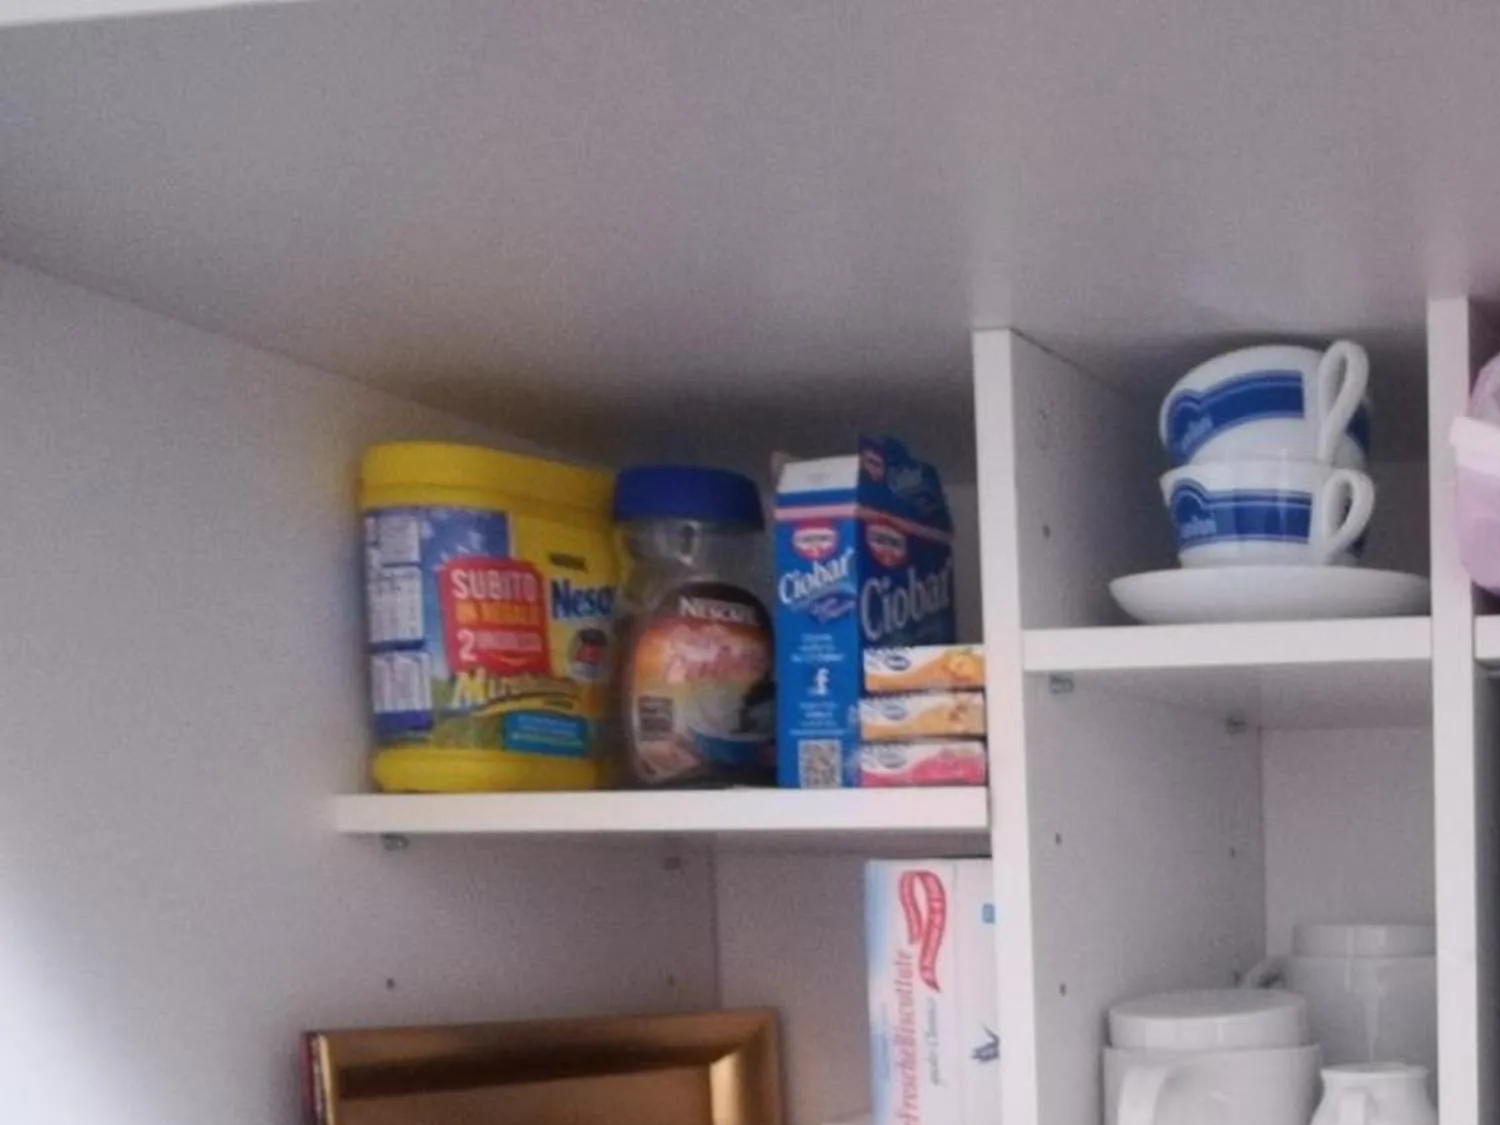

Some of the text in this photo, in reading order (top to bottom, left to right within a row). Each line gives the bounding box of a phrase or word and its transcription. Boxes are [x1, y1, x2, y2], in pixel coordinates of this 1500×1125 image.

[450, 569, 537, 602] SUBITO
[779, 547, 854, 604] Ciobar
[860, 564, 950, 642] Ciobar
[457, 629, 477, 662] 2
